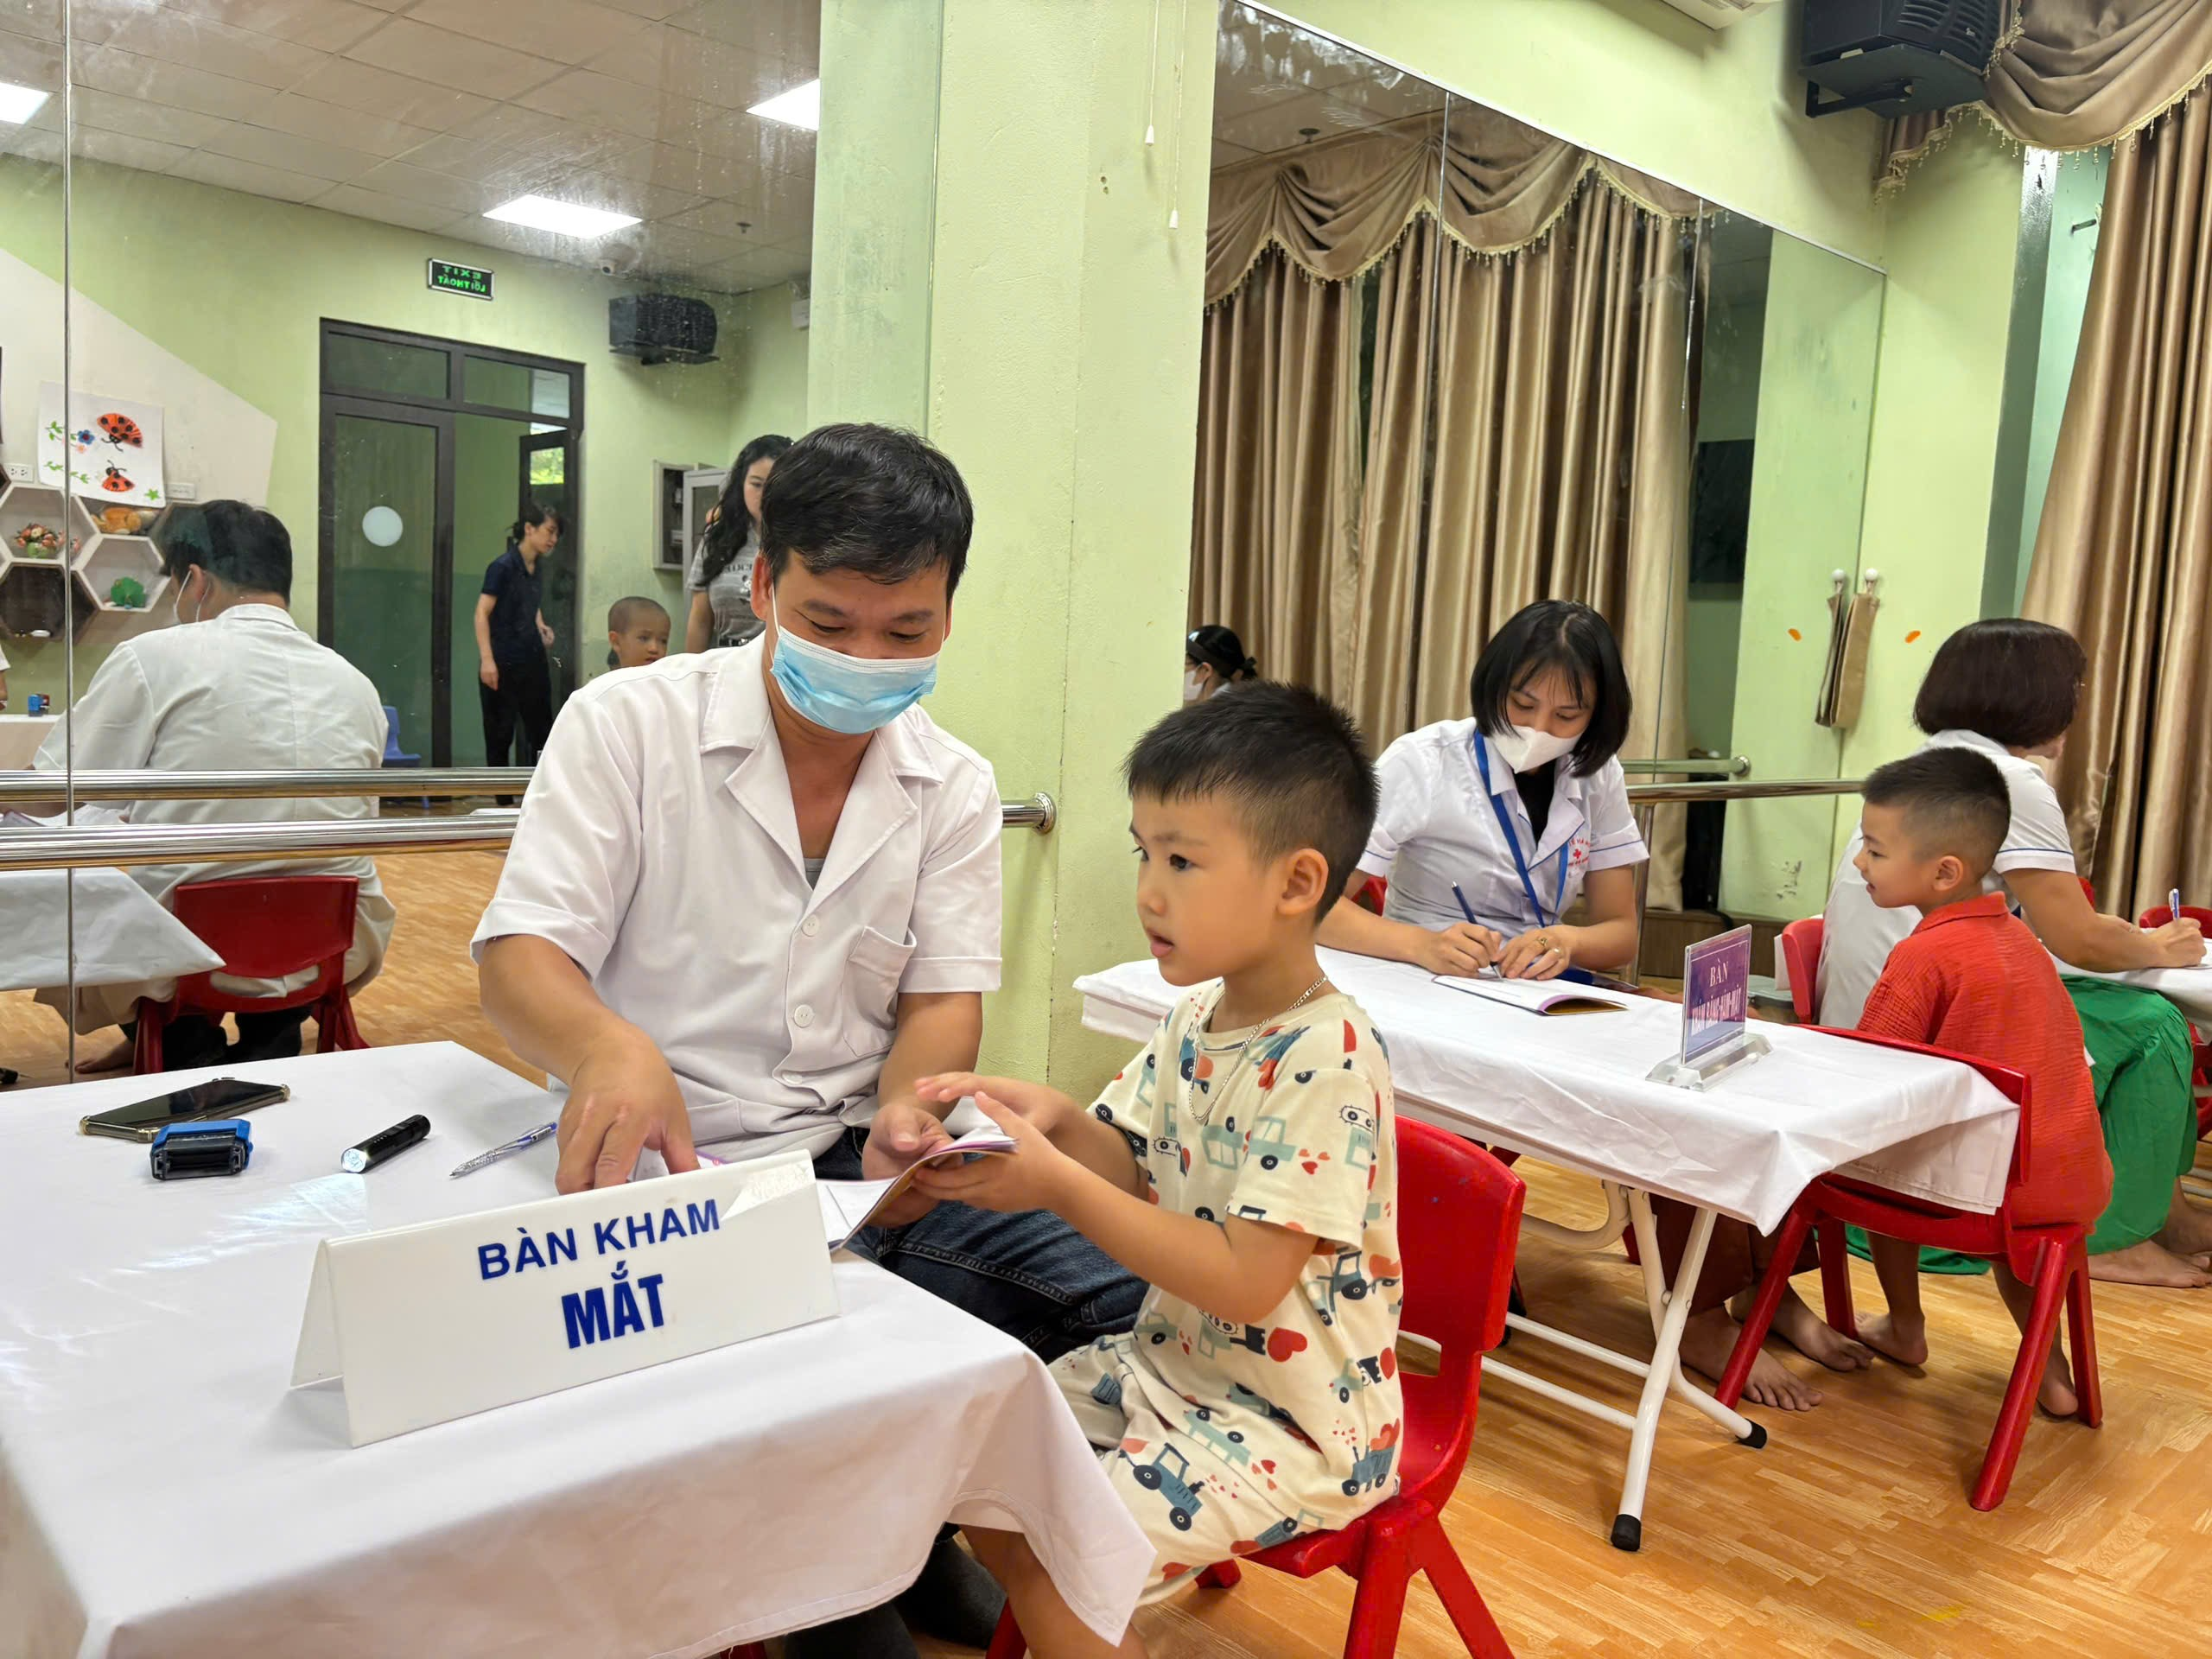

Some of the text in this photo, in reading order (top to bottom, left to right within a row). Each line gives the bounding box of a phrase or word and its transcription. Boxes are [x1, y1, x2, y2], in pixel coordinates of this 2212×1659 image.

[1710, 958, 1729, 987] BÀN
[478, 1198, 721, 1281] BÀN KHAM
[561, 1260, 665, 1350] MẮT
